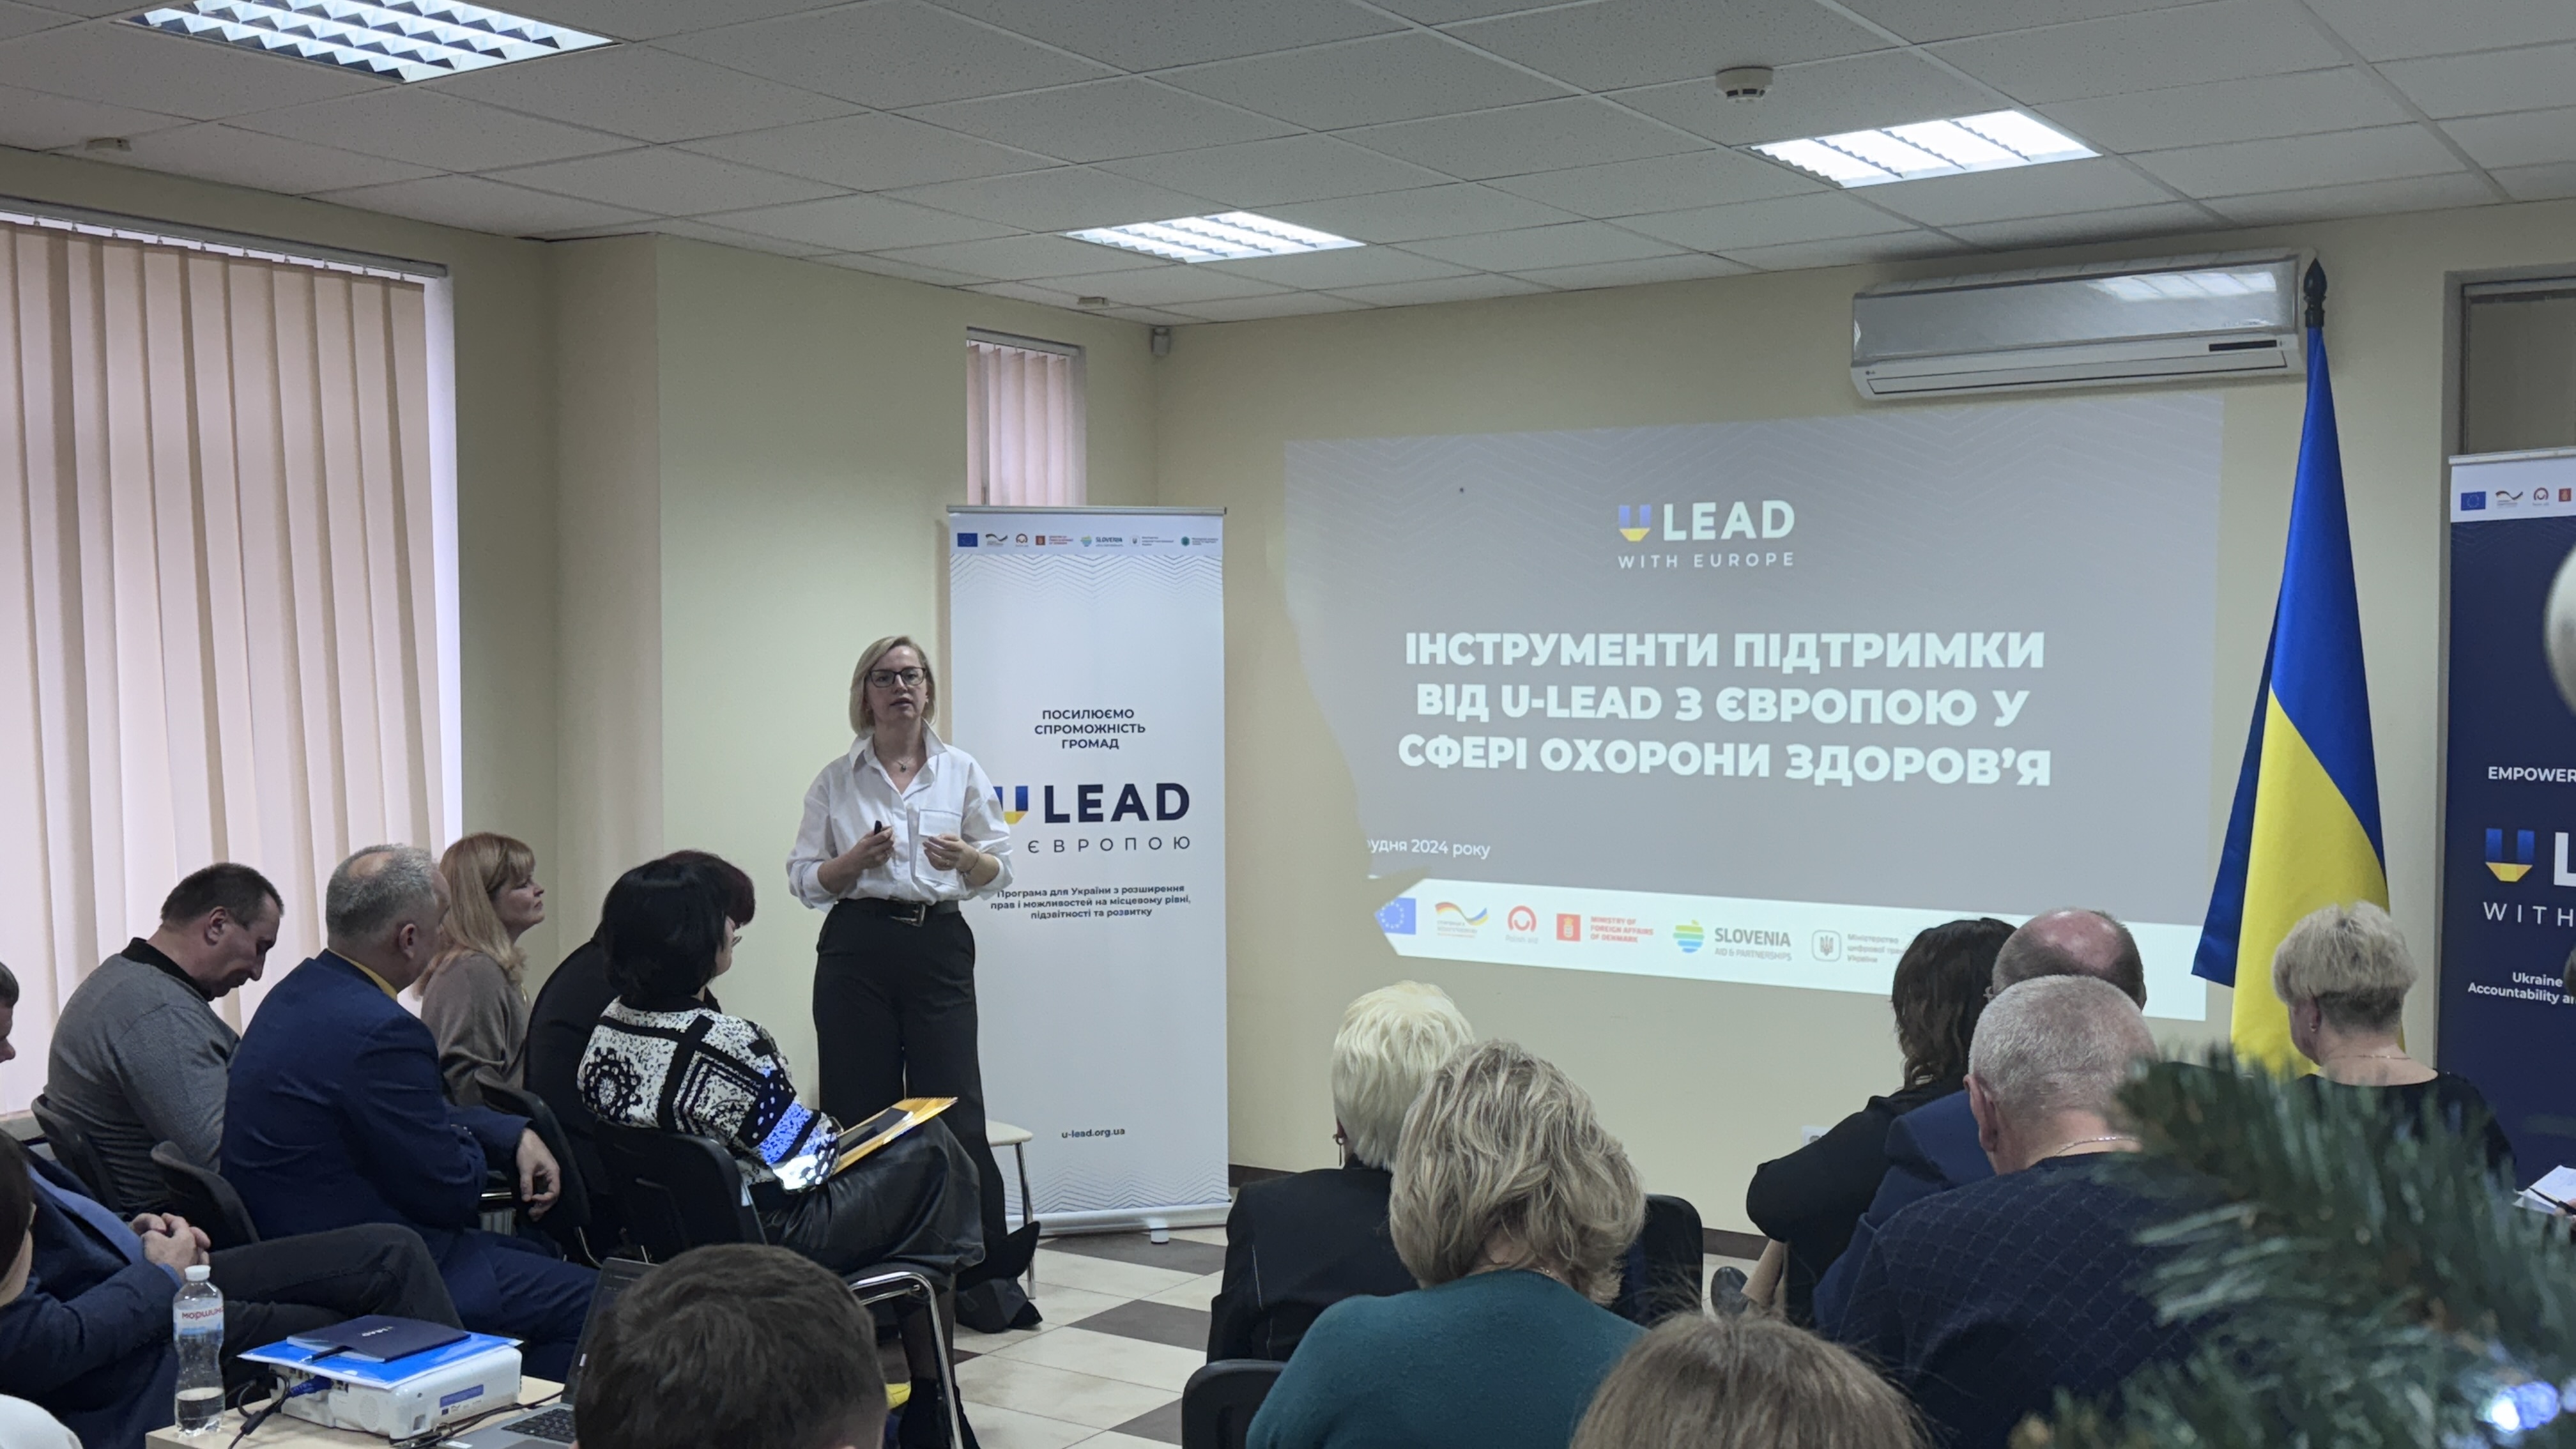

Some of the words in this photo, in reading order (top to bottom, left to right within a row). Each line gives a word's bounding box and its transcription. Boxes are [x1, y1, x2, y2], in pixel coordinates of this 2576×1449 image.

[1664, 500, 1795, 540] LEAD
[1618, 555, 1678, 569] WITH
[1694, 552, 1793, 568] EUROPE
[1406, 632, 1718, 666] ІНСТРУМЕНТИ
[1734, 631, 2044, 674] ПІДТРИМКИ
[1417, 683, 1489, 723] ВІД
[1501, 684, 1662, 719] U-LEAD
[1675, 686, 1703, 721] З
[1716, 686, 1977, 726] ЄВРОПОЮ
[1992, 690, 2030, 727] У
[1042, 709, 1135, 720] ПОСИЛЮЄМО
[1034, 723, 1146, 735] СПРОМОЖНІСТЬ
[1062, 739, 1119, 749] ГРОМАД
[1399, 733, 1527, 769] СФЕРІ
[1540, 737, 1770, 778] ОХОРОНИ
[1784, 743, 2051, 786] ЗДОРОВ’Я
[2488, 766, 2576, 783] EMPOWER
[1045, 783, 1190, 824] LEAD
[1028, 836, 1190, 854] ЄВРОПОЮ
[1411, 838, 1448, 854] 2024
[1453, 843, 1491, 859] року
[997, 889, 1047, 899] Програма
[1050, 888, 1068, 896] для
[1071, 887, 1111, 896] України
[1121, 885, 1184, 894] розширення
[990, 902, 1015, 910] прав
[1023, 898, 1092, 908] можливостей
[1110, 896, 1162, 905] місцевому
[1031, 908, 1091, 919] підзвітності
[1107, 908, 1153, 917] розвитку
[2483, 901, 2574, 927] WITH
[1715, 928, 1791, 947] SLOVENIA
[2512, 972, 2563, 987] Ukraine
[2468, 982, 2559, 1004] Accountability
[1061, 1128, 1125, 1138] u-lead.org.ua
